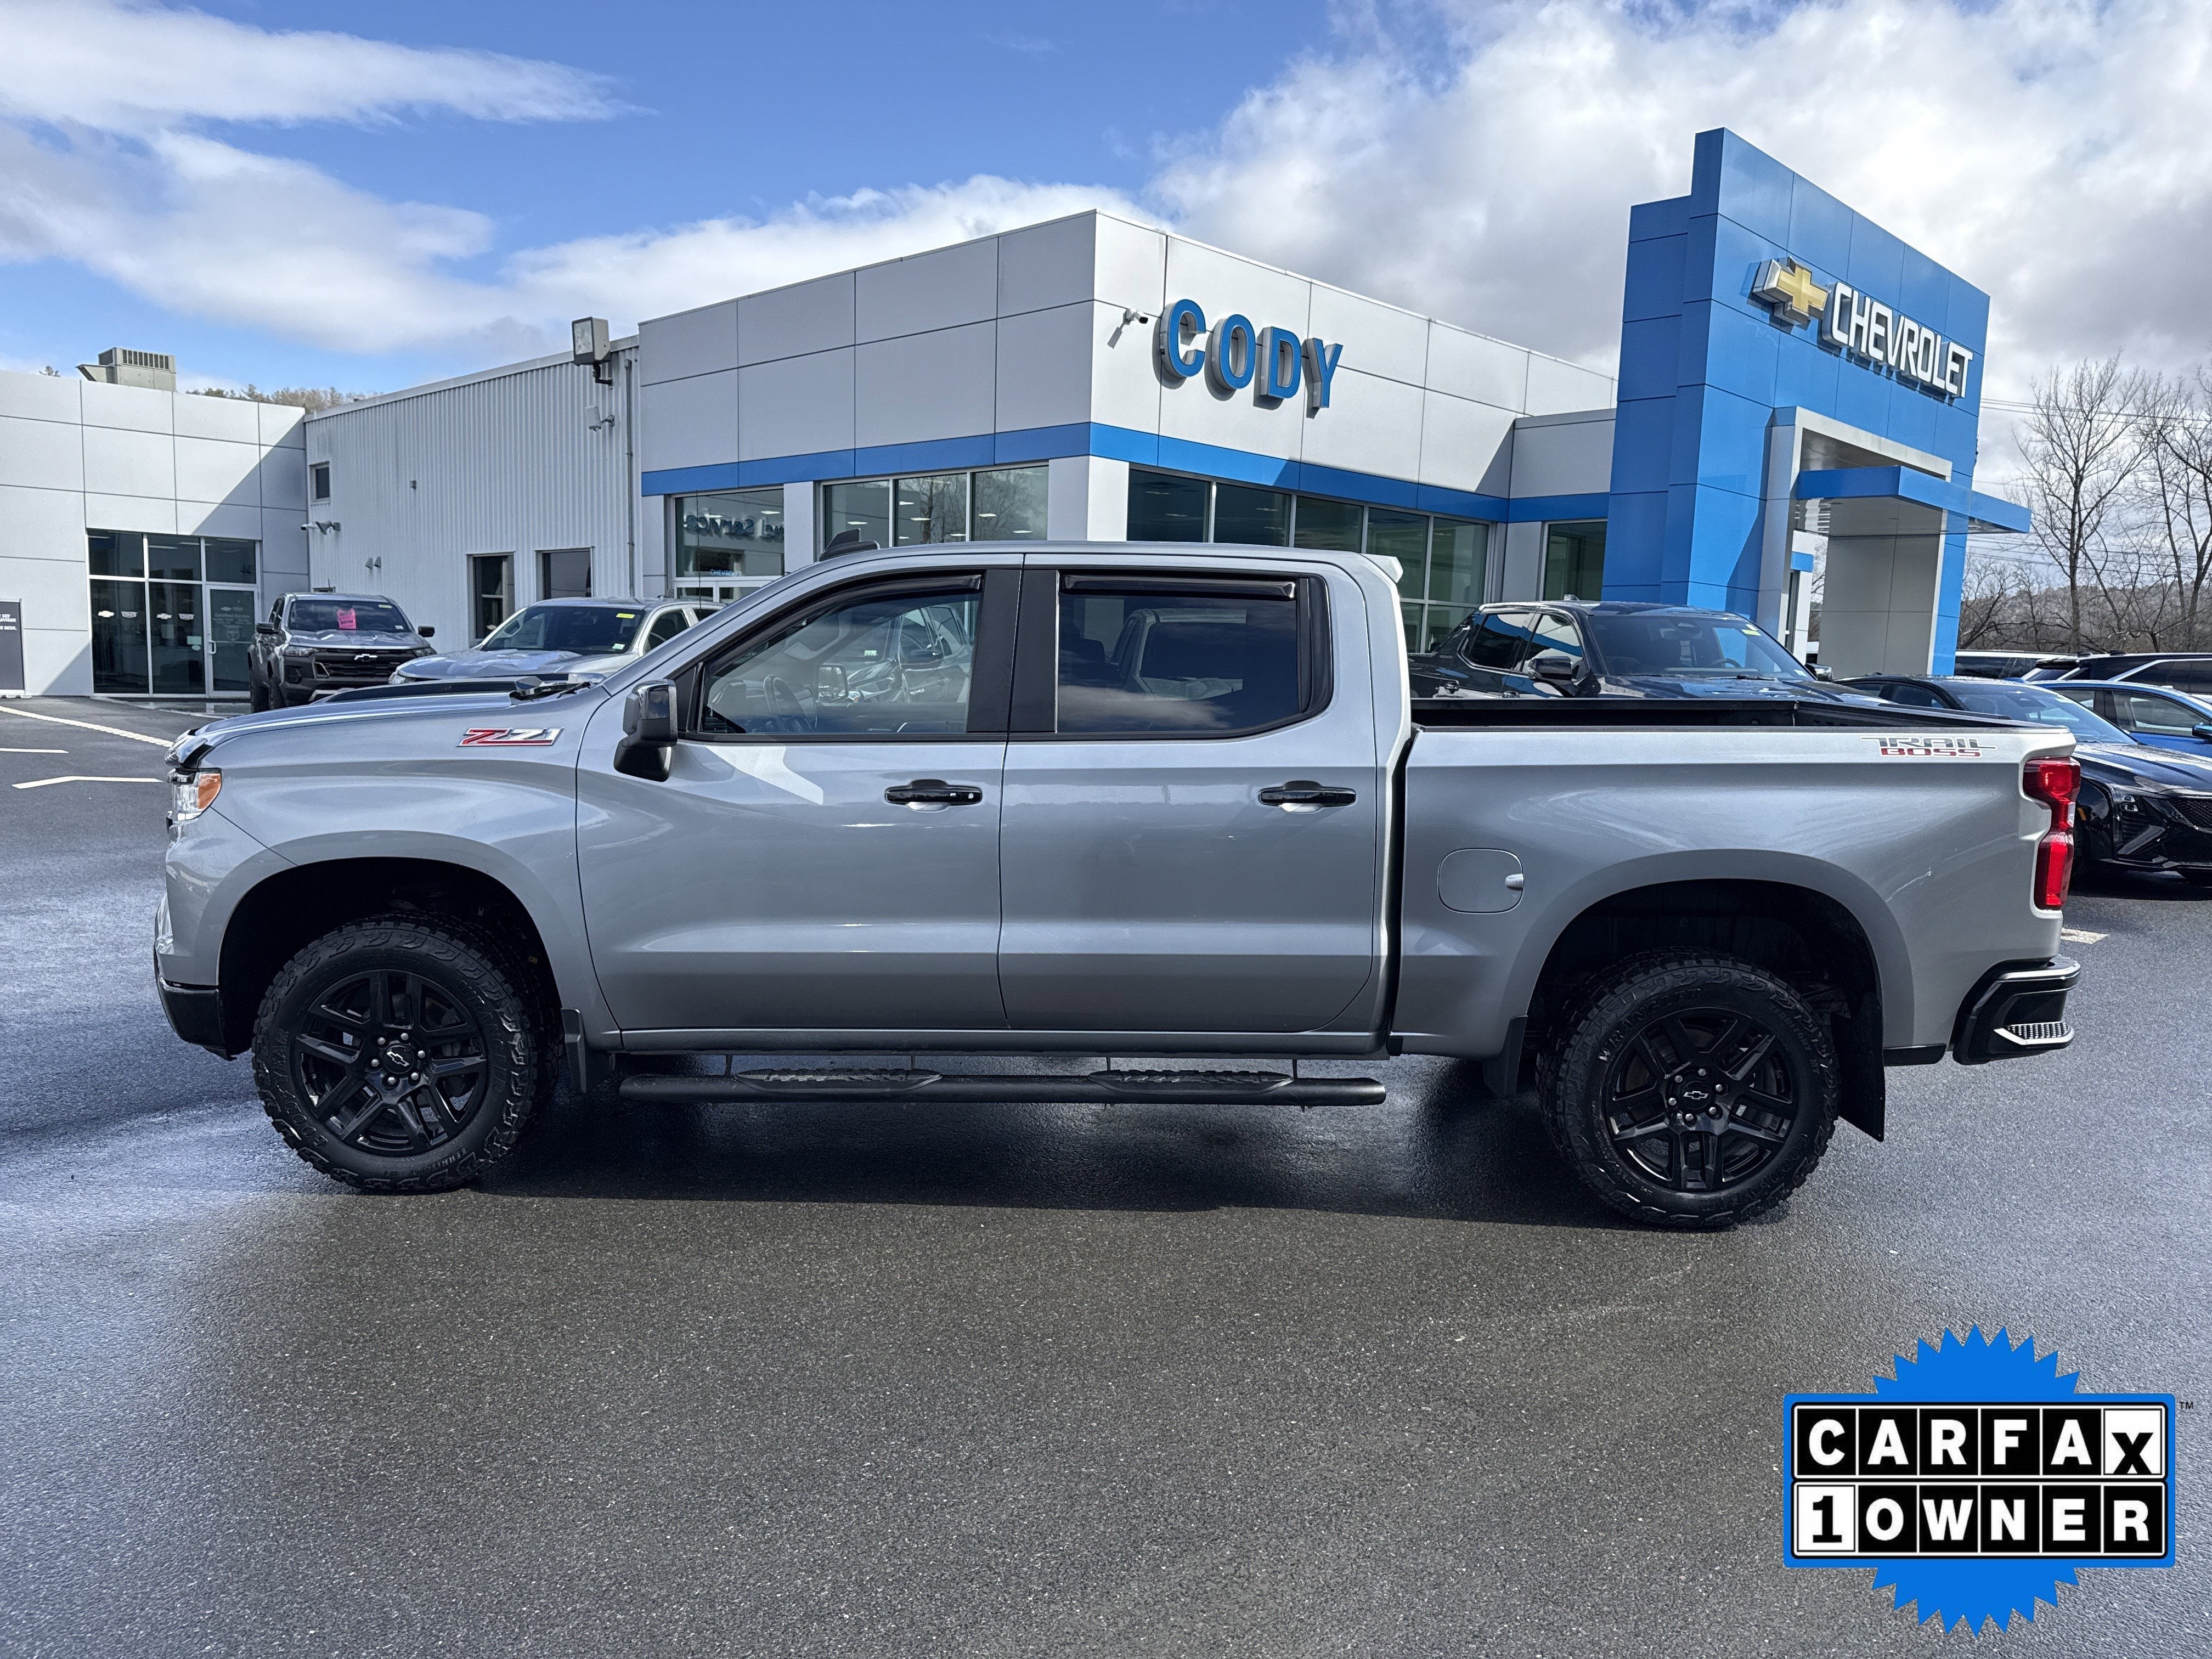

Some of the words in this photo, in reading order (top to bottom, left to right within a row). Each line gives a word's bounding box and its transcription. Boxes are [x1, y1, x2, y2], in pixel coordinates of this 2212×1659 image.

[1160, 298, 1344, 408] CODY
[1826, 281, 1973, 398] CHEVROLET
[456, 727, 564, 747] Z71
[1860, 737, 1996, 749] TRAIL
[1880, 747, 1982, 758] BOSS
[273, 1028, 329, 1148] GOODYEAR
